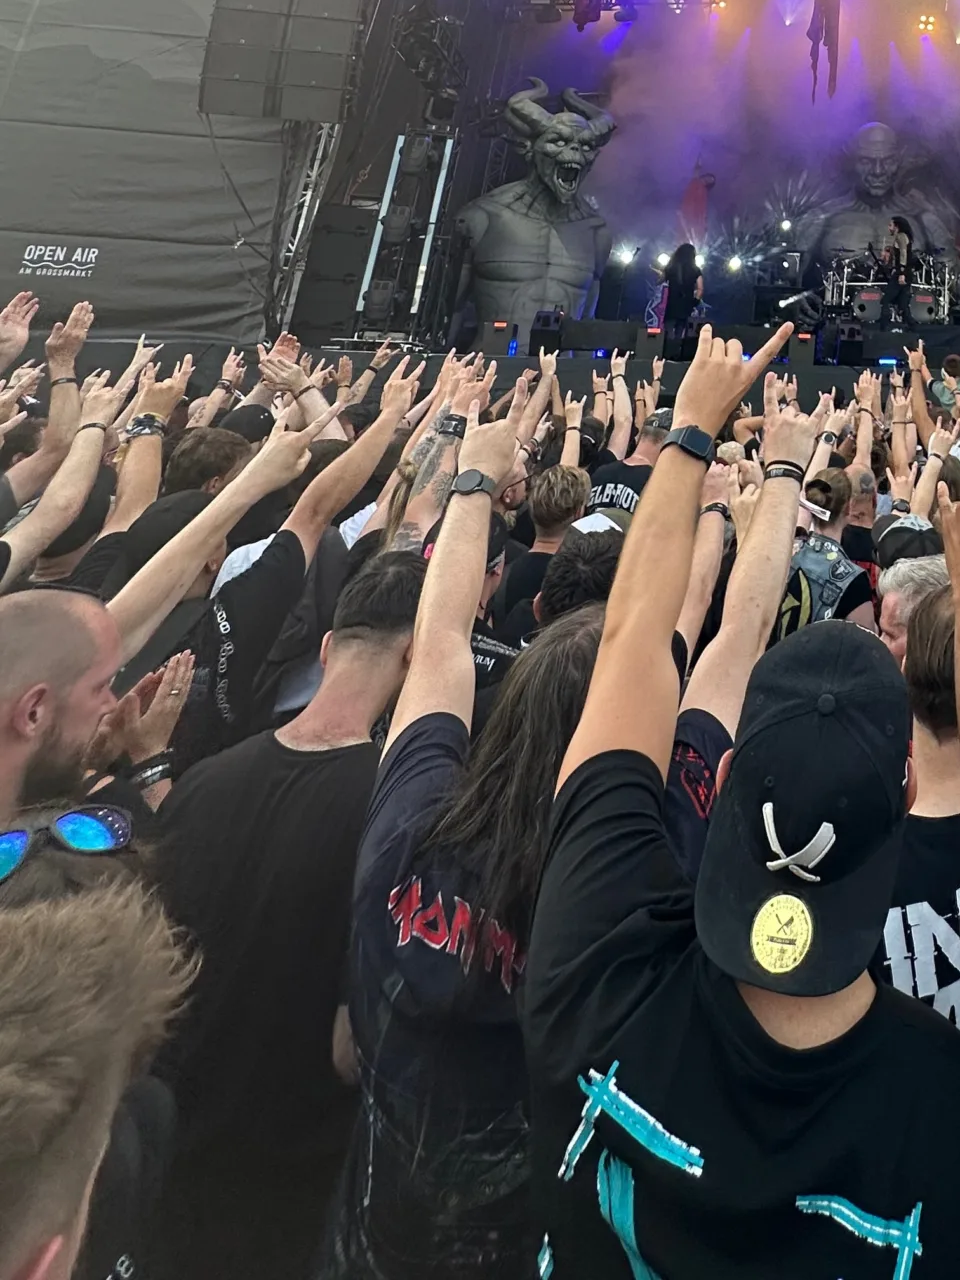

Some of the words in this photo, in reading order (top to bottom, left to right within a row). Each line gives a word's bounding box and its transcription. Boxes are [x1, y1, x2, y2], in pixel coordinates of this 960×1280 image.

[24, 244, 67, 261] OPEN
[72, 247, 99, 263] AIR
[19, 267, 32, 275] AM
[36, 268, 93, 277] GROSSMARKT
